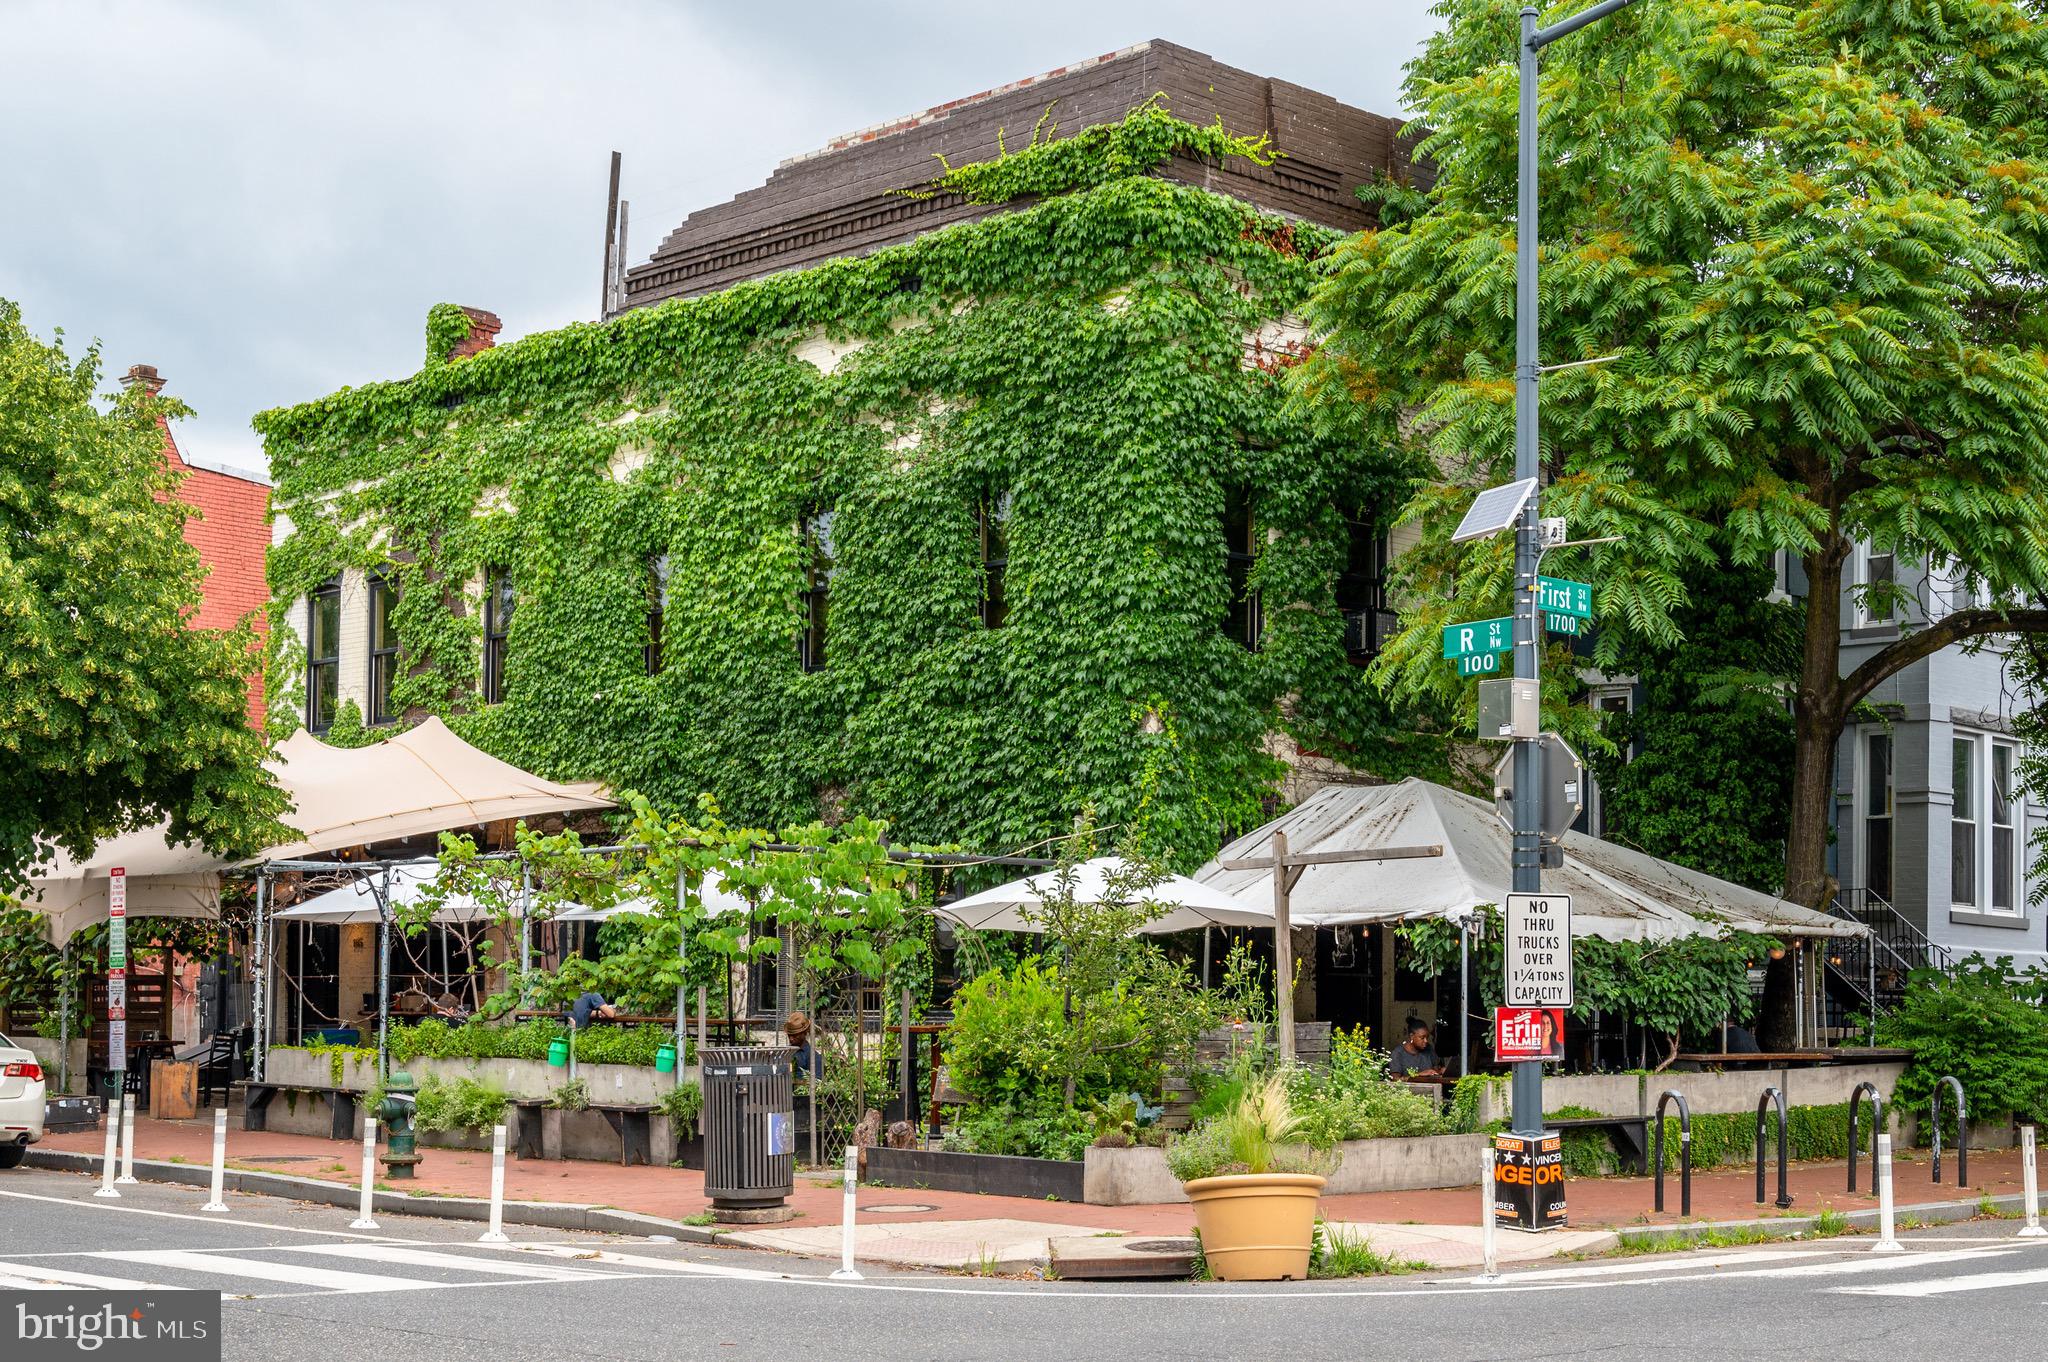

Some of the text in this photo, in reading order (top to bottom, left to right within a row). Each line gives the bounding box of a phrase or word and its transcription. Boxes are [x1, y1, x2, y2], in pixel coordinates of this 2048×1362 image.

[1540, 581, 1586, 609] First St
[1549, 613, 1576, 632] 1700
[1460, 622, 1500, 652] R St
[1464, 654, 1494, 672] 100
[1529, 900, 1548, 914] NO
[1523, 918, 1554, 931] THRU
[1518, 936, 1559, 949] TRUCKS
[1524, 953, 1553, 965] OVER
[1536, 971, 1565, 981] TONS
[1515, 986, 1563, 1000] CAPACITY
[1502, 1019, 1541, 1038] Erin
